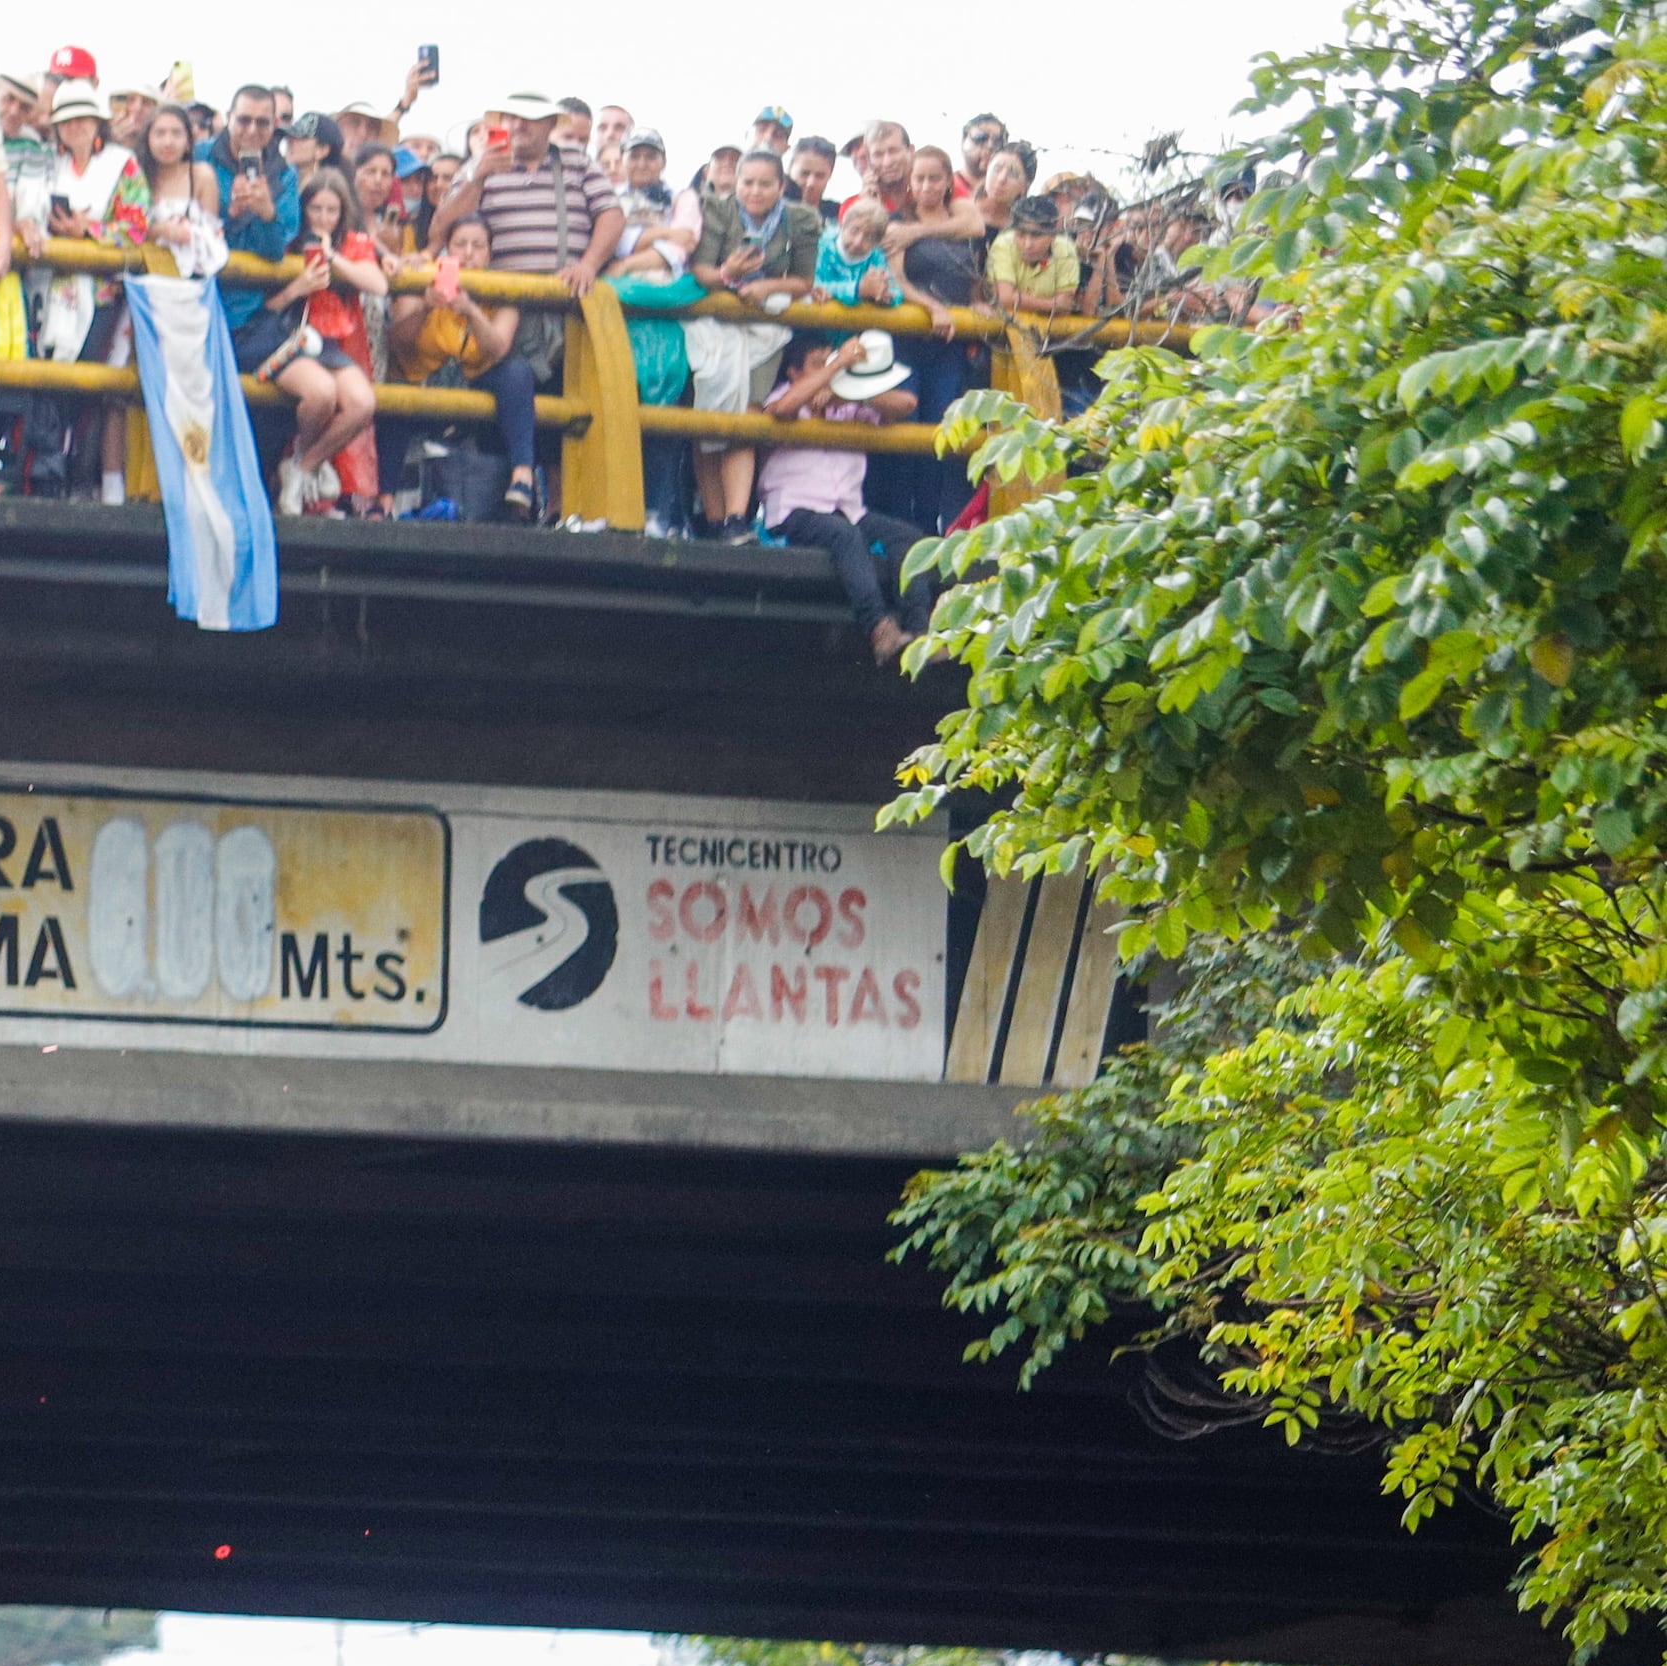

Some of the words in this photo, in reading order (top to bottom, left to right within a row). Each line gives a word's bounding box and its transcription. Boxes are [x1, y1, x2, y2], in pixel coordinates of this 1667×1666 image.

[646, 835, 843, 873] TECNICENTRO
[646, 879, 867, 949] SOMOS
[280, 932, 426, 1003] Mts.
[649, 958, 921, 1030] LLANTAS
